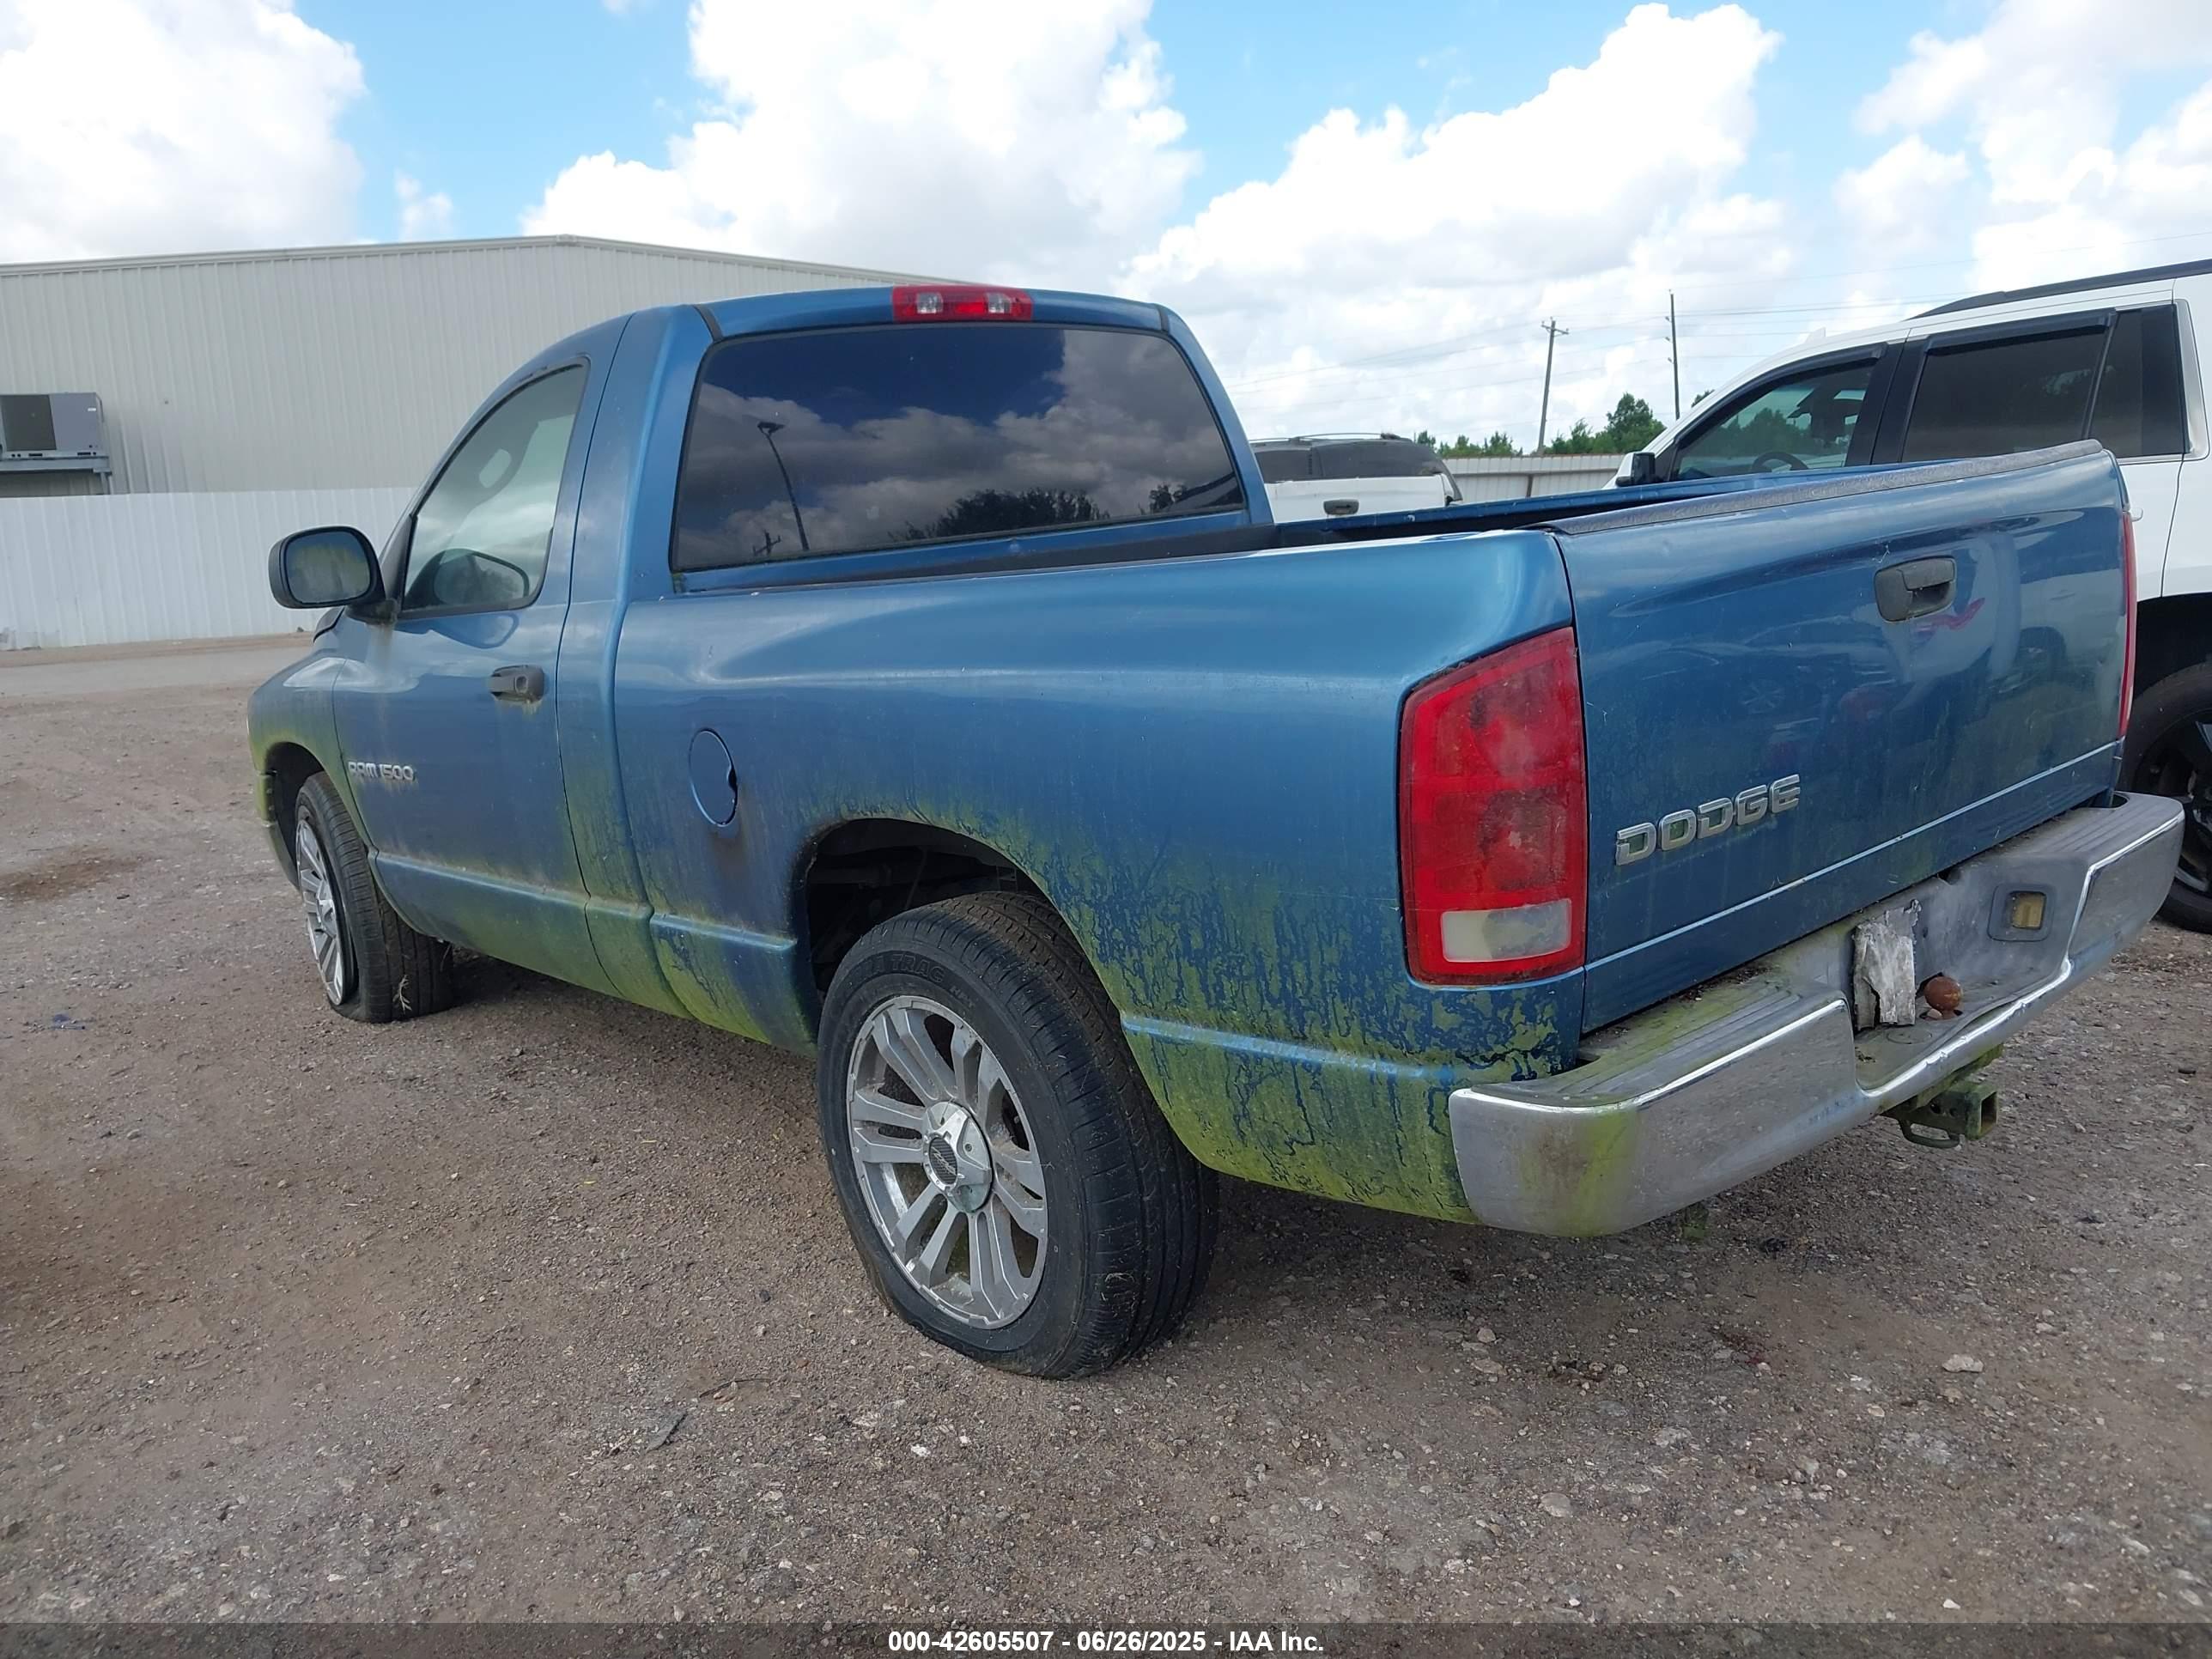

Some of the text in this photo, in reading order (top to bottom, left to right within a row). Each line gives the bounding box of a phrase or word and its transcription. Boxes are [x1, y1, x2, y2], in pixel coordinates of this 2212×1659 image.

[348, 761, 415, 781] RAM 1500
[1615, 774, 1801, 866] DODGE
